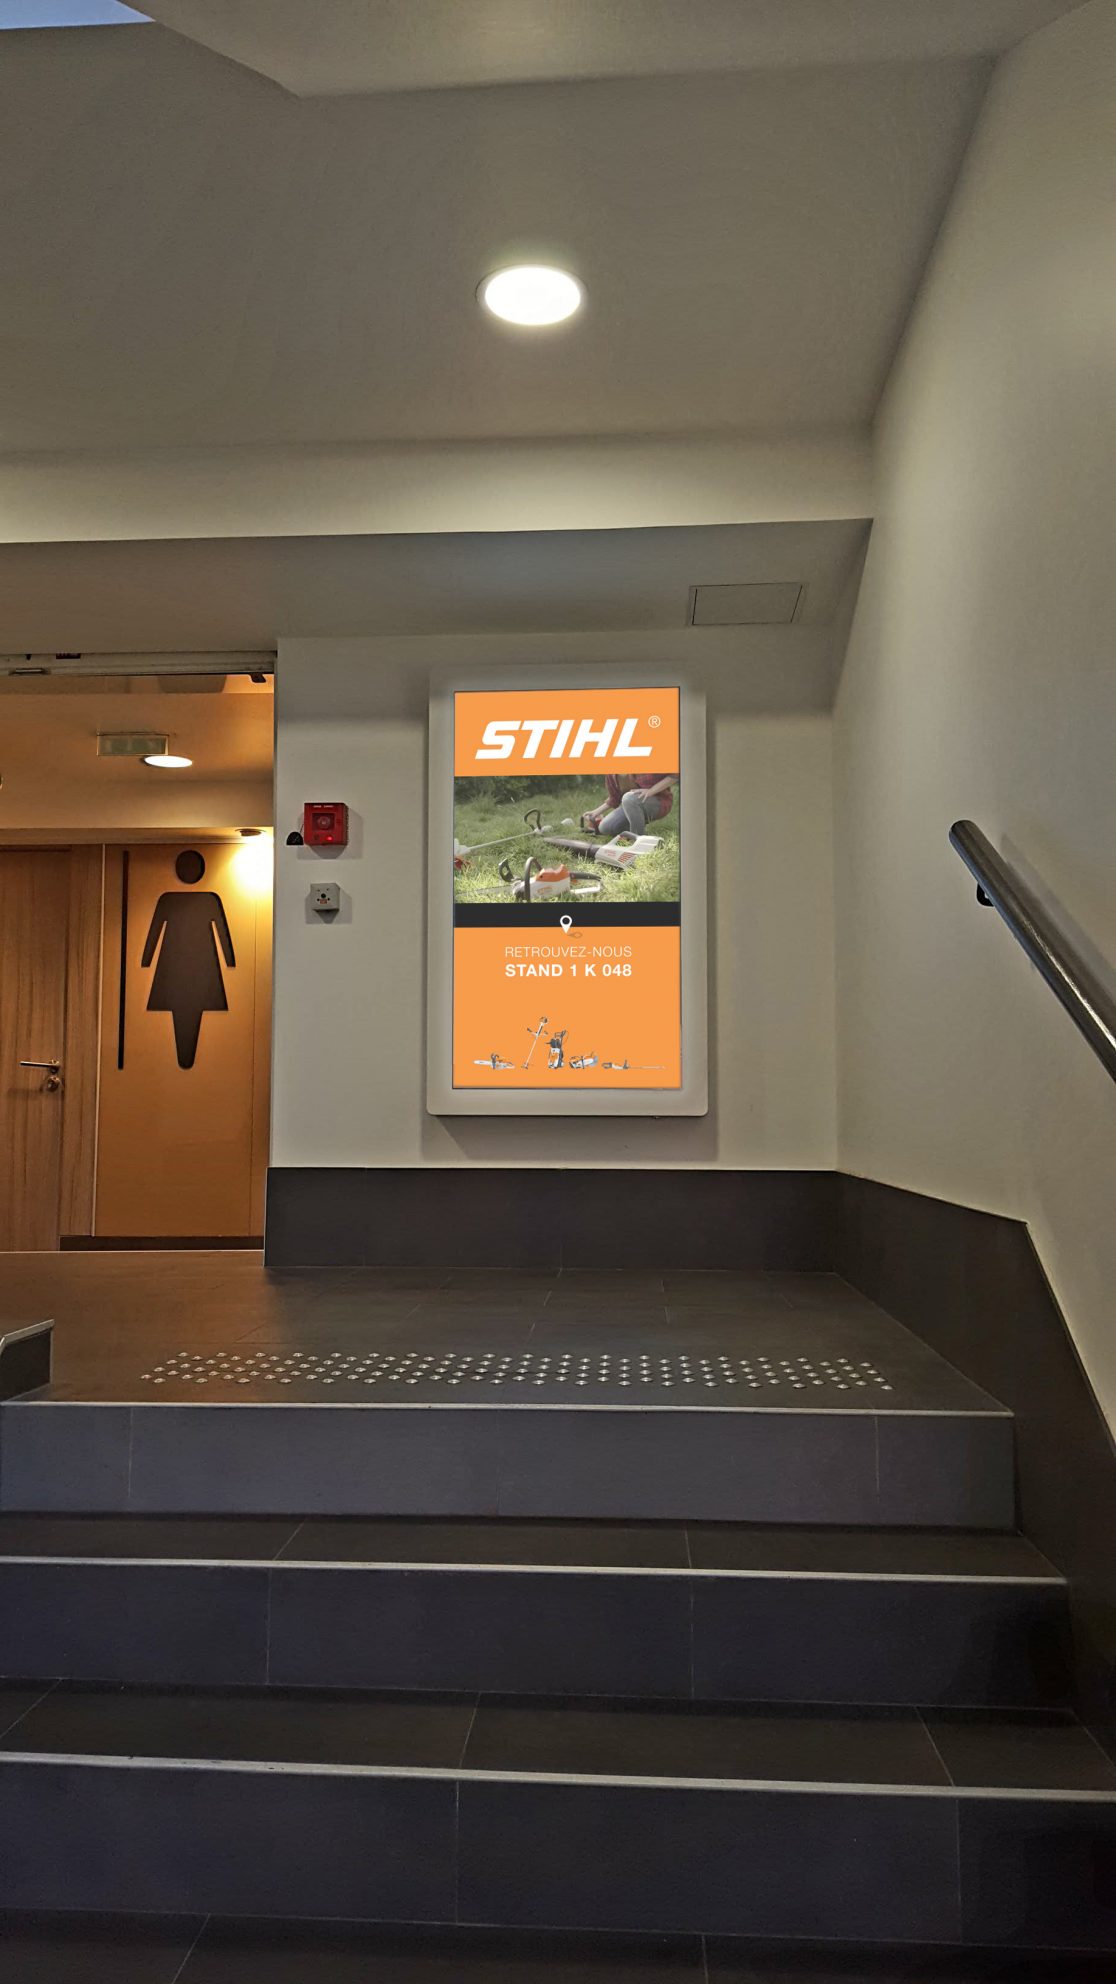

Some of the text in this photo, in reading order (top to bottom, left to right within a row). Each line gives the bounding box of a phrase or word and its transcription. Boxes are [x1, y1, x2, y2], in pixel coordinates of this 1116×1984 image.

[475, 718, 653, 760] STIHL
[504, 946, 632, 958] RETROUVEZ-NOUS
[505, 963, 632, 977] STAND 1 K 048
